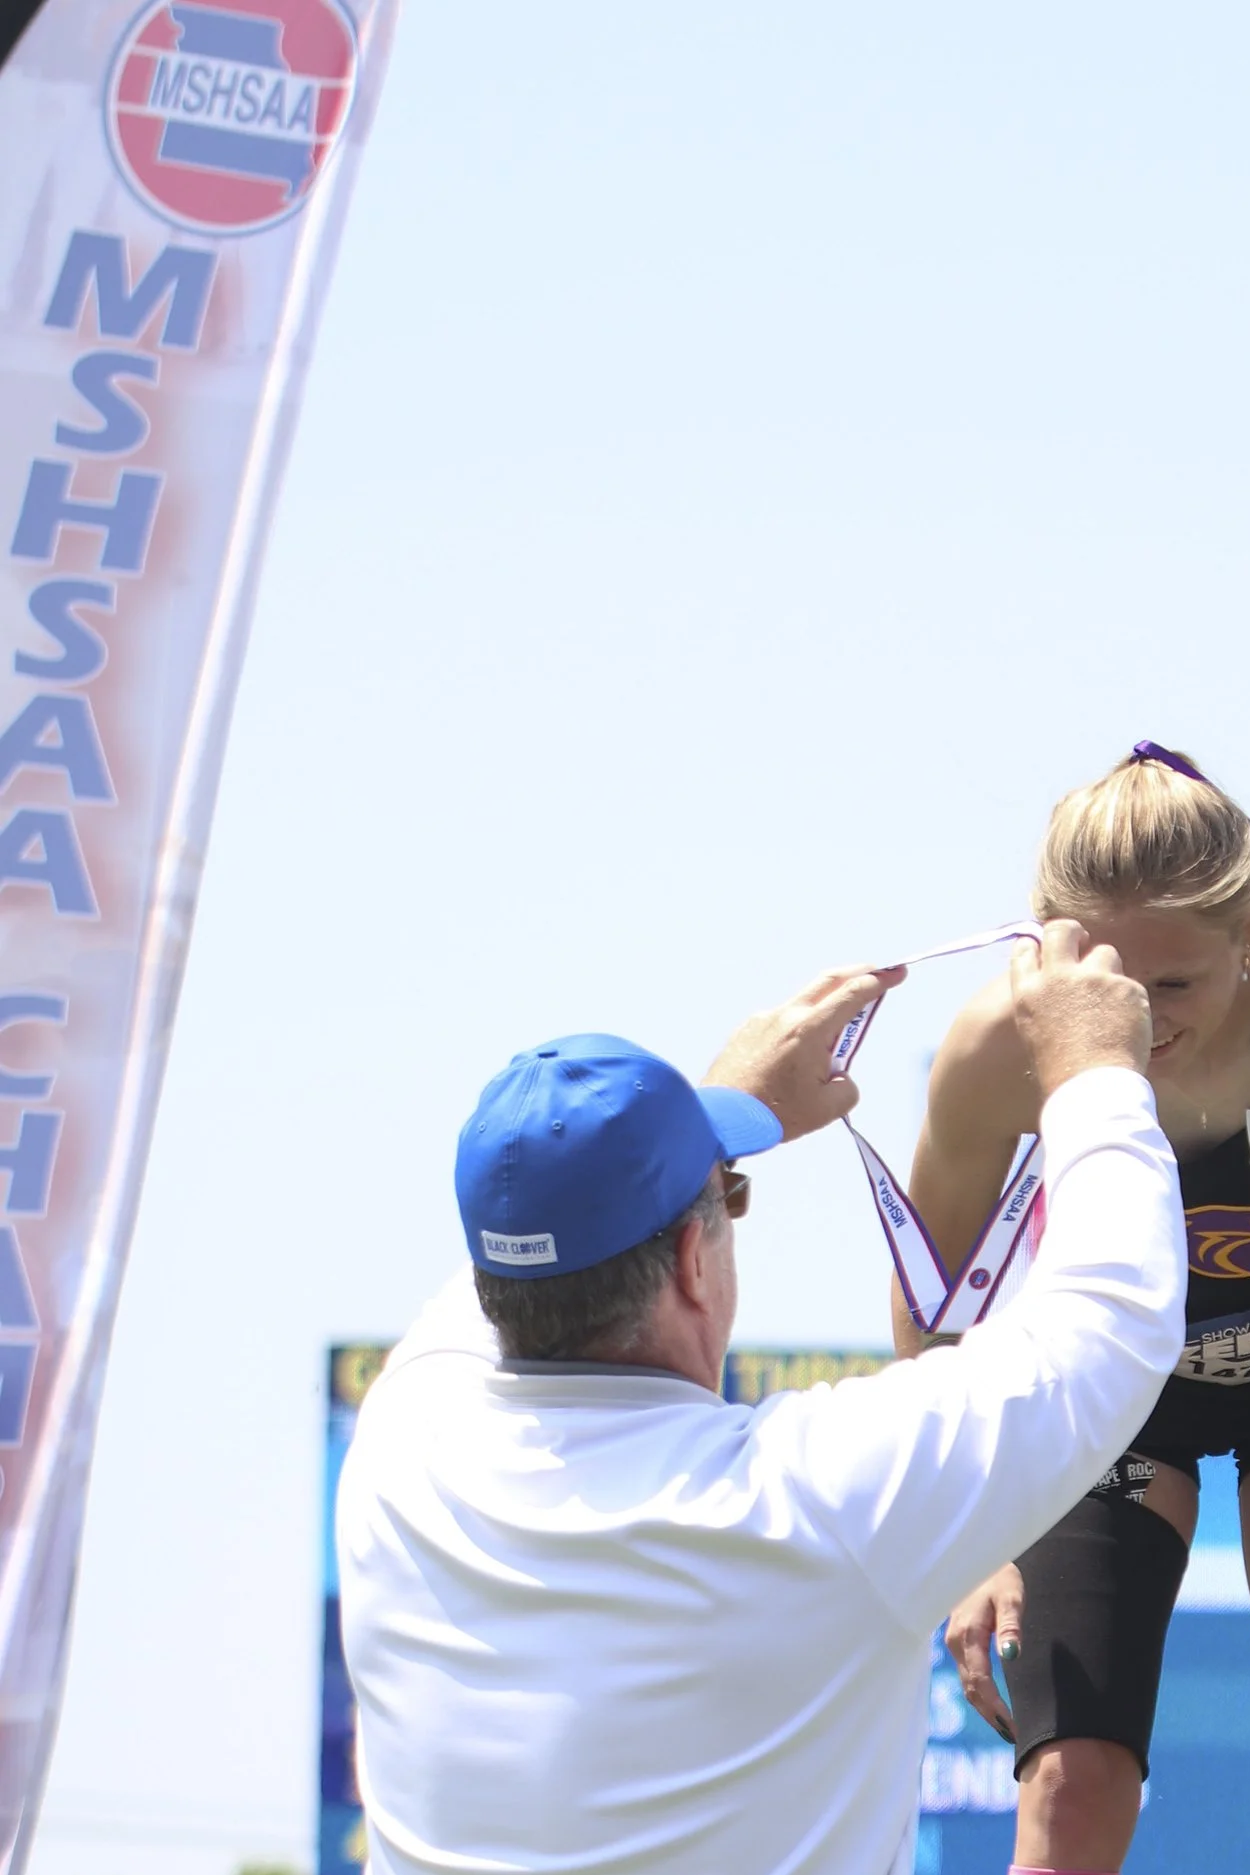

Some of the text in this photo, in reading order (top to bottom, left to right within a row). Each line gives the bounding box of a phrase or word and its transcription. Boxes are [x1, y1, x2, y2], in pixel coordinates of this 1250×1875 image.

[150, 57, 317, 134] MSHSAA
[878, 1176, 908, 1228] MSHSAA
[1002, 1174, 1038, 1223] MSHSAA
